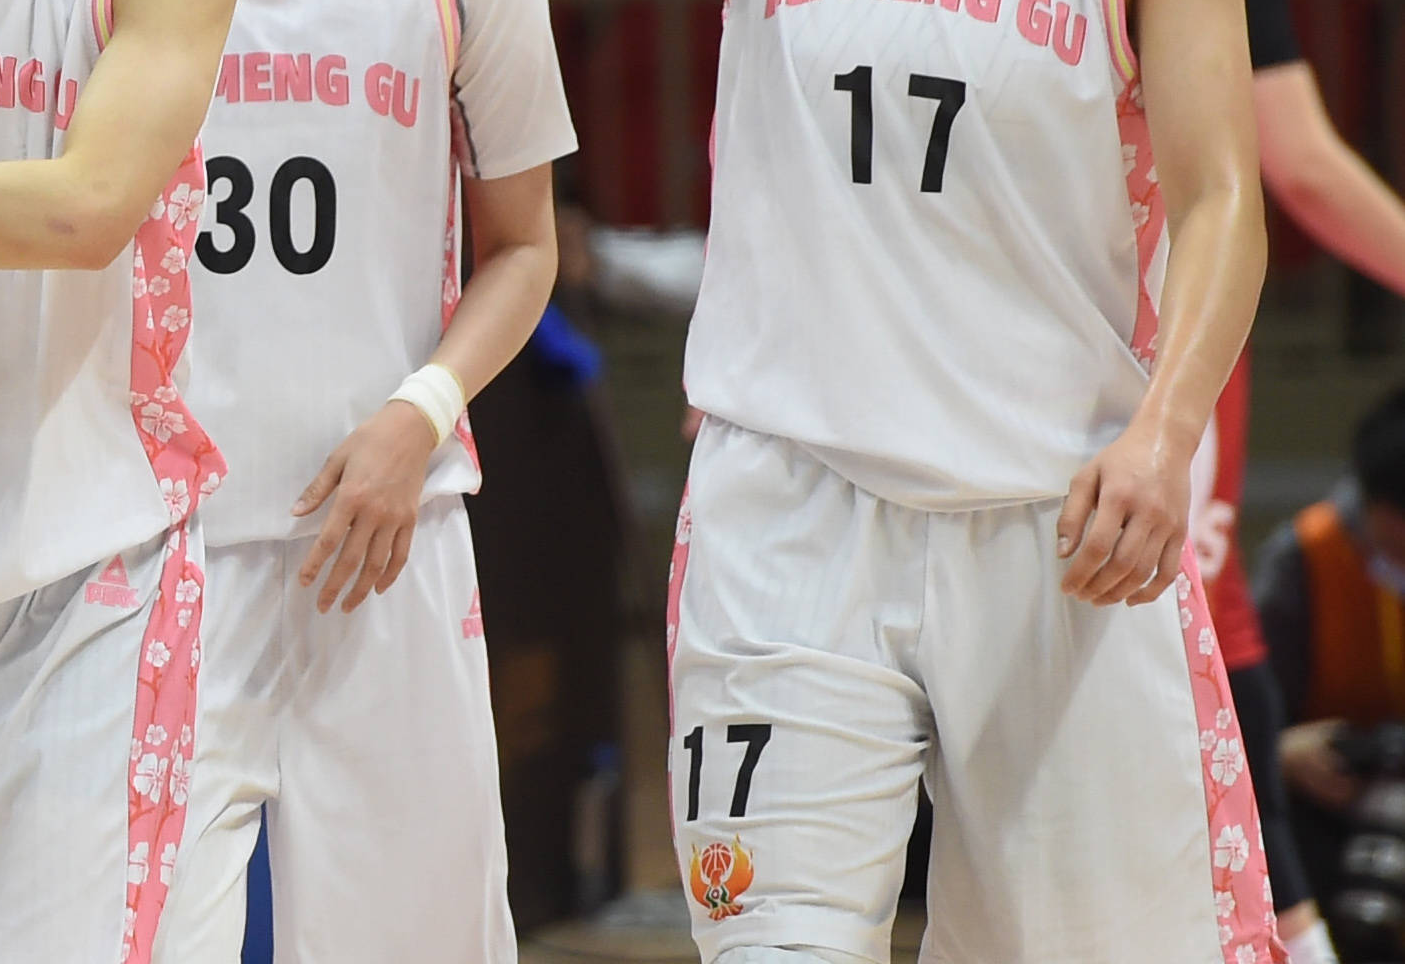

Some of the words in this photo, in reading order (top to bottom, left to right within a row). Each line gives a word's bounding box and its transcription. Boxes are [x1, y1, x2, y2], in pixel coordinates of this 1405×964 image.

[364, 62, 420, 128] GU
[834, 65, 966, 193] 17
[195, 155, 337, 276] 30
[683, 723, 772, 821] 17
